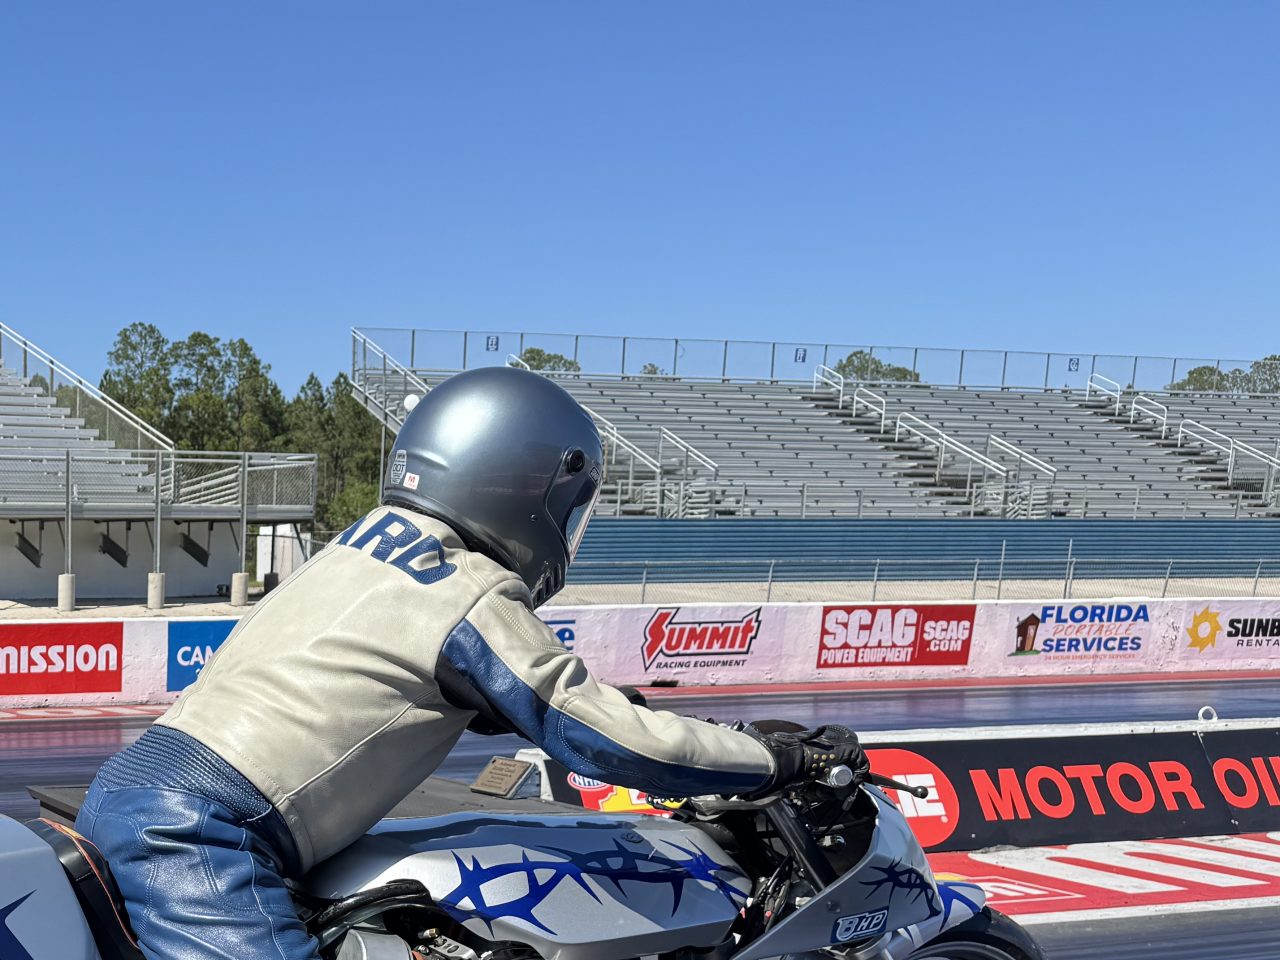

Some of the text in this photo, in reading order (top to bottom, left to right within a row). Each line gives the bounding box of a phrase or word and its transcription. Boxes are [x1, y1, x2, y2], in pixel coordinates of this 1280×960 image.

[1040, 605, 1149, 624] FLORIDA
[823, 608, 918, 648] SCAG
[923, 620, 970, 641] SCAG
[926, 640, 962, 651] .COM
[1041, 636, 1141, 653] SERVICES
[656, 659, 747, 669] RACING EQUIPMENT
[821, 647, 913, 665] POWER EQUIPMENT
[969, 759, 1205, 822] MOTOR
[836, 910, 887, 941] BHP
